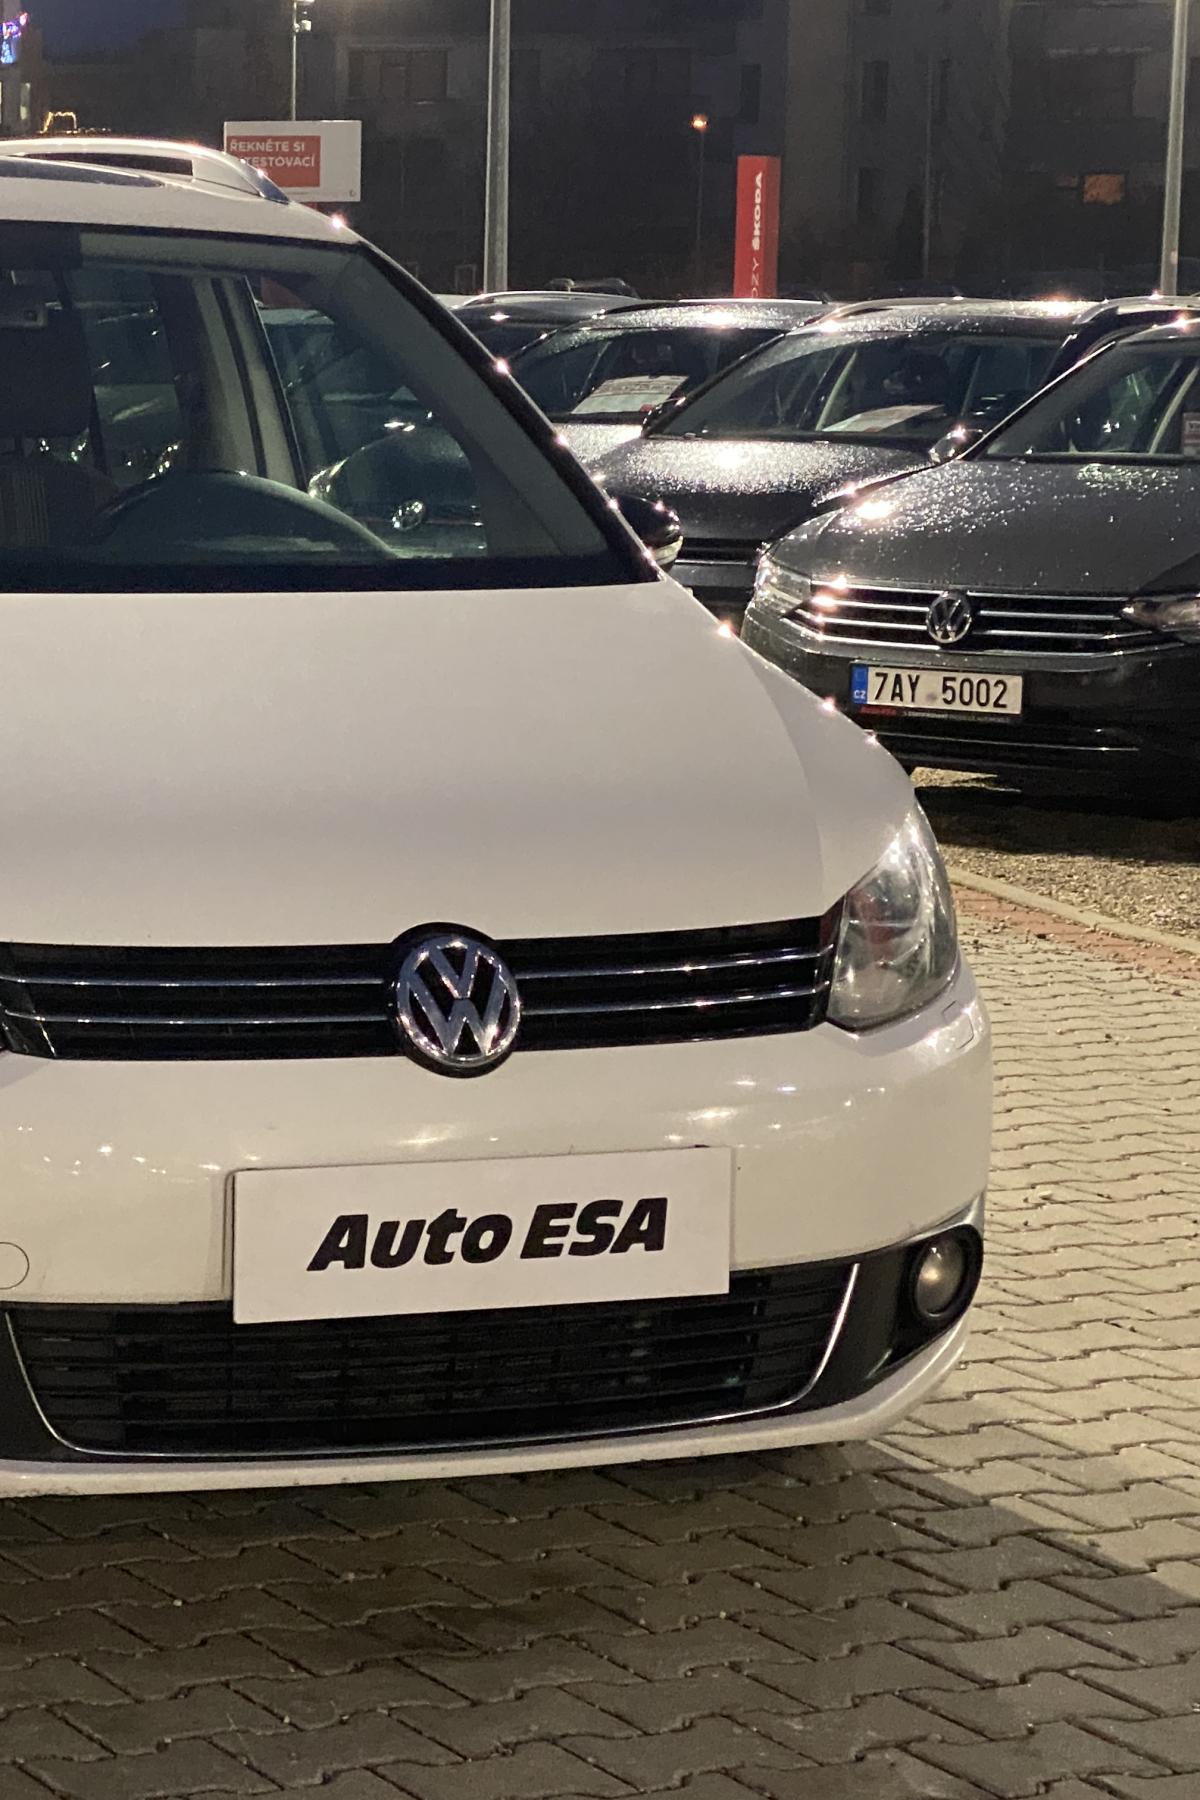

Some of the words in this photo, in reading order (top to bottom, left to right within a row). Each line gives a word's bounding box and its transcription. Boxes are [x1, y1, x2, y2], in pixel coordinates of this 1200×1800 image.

[230, 138, 289, 152] ŘEKNĚTE
[293, 141, 305, 152] SI
[751, 171, 762, 251] ŠKODA
[853, 690, 866, 699] CZ
[874, 672, 920, 703] 7AY
[941, 676, 1008, 709] 5002
[306, 1207, 514, 1273] Auto
[519, 1196, 669, 1261] ESA
